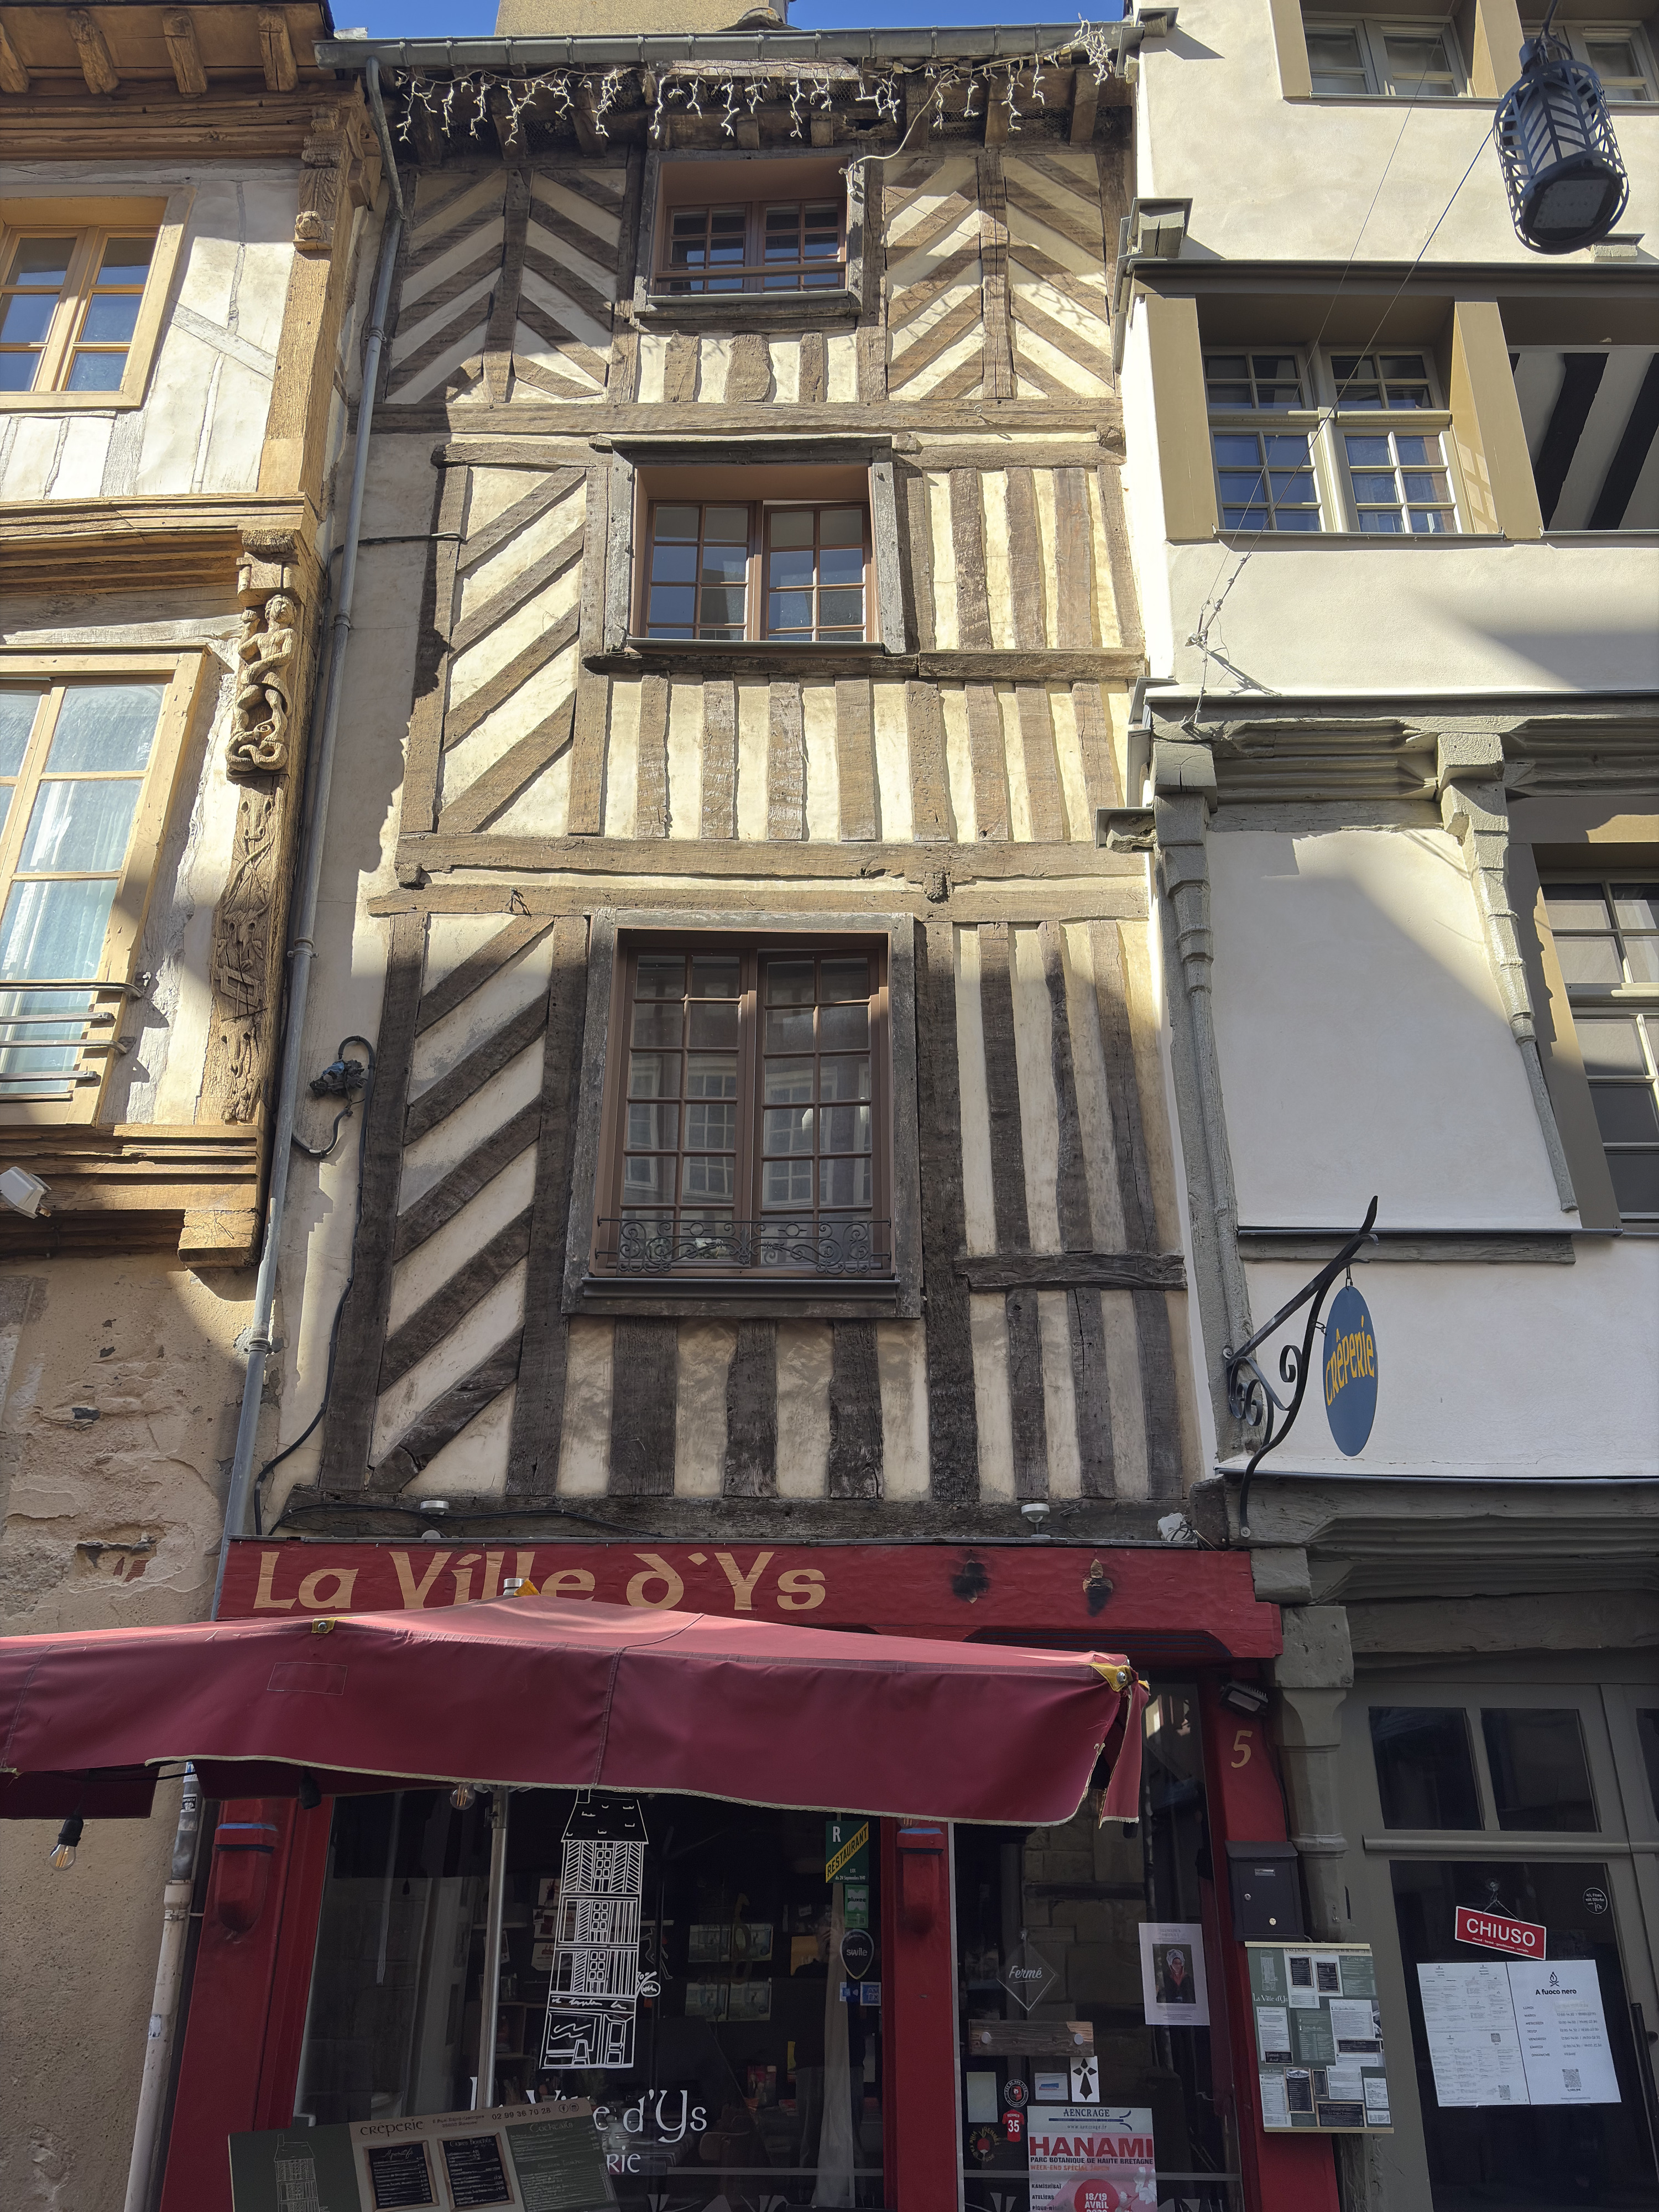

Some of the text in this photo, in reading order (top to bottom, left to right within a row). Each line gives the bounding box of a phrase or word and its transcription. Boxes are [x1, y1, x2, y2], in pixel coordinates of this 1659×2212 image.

[253, 1551, 827, 1611] La Ville d'Ys
[1231, 1730, 1253, 1768] 5
[833, 1826, 841, 1842] R
[827, 1826, 867, 1878] RESTAURANT
[1467, 1918, 1535, 1947] CHIUSO
[846, 1947, 868, 1957] swile
[1009, 1965, 1042, 1979] Fermé
[1253, 1992, 1260, 2001] La
[623, 2089, 708, 2143] d'Ys
[1063, 2108, 1110, 2117] AENCRAGE
[1008, 2120, 1020, 2132] 35
[1029, 2136, 1154, 2158] HANAMI
[1084, 2200, 1109, 2209] AVRIL
[1085, 2193, 1108, 2201] 18/19
